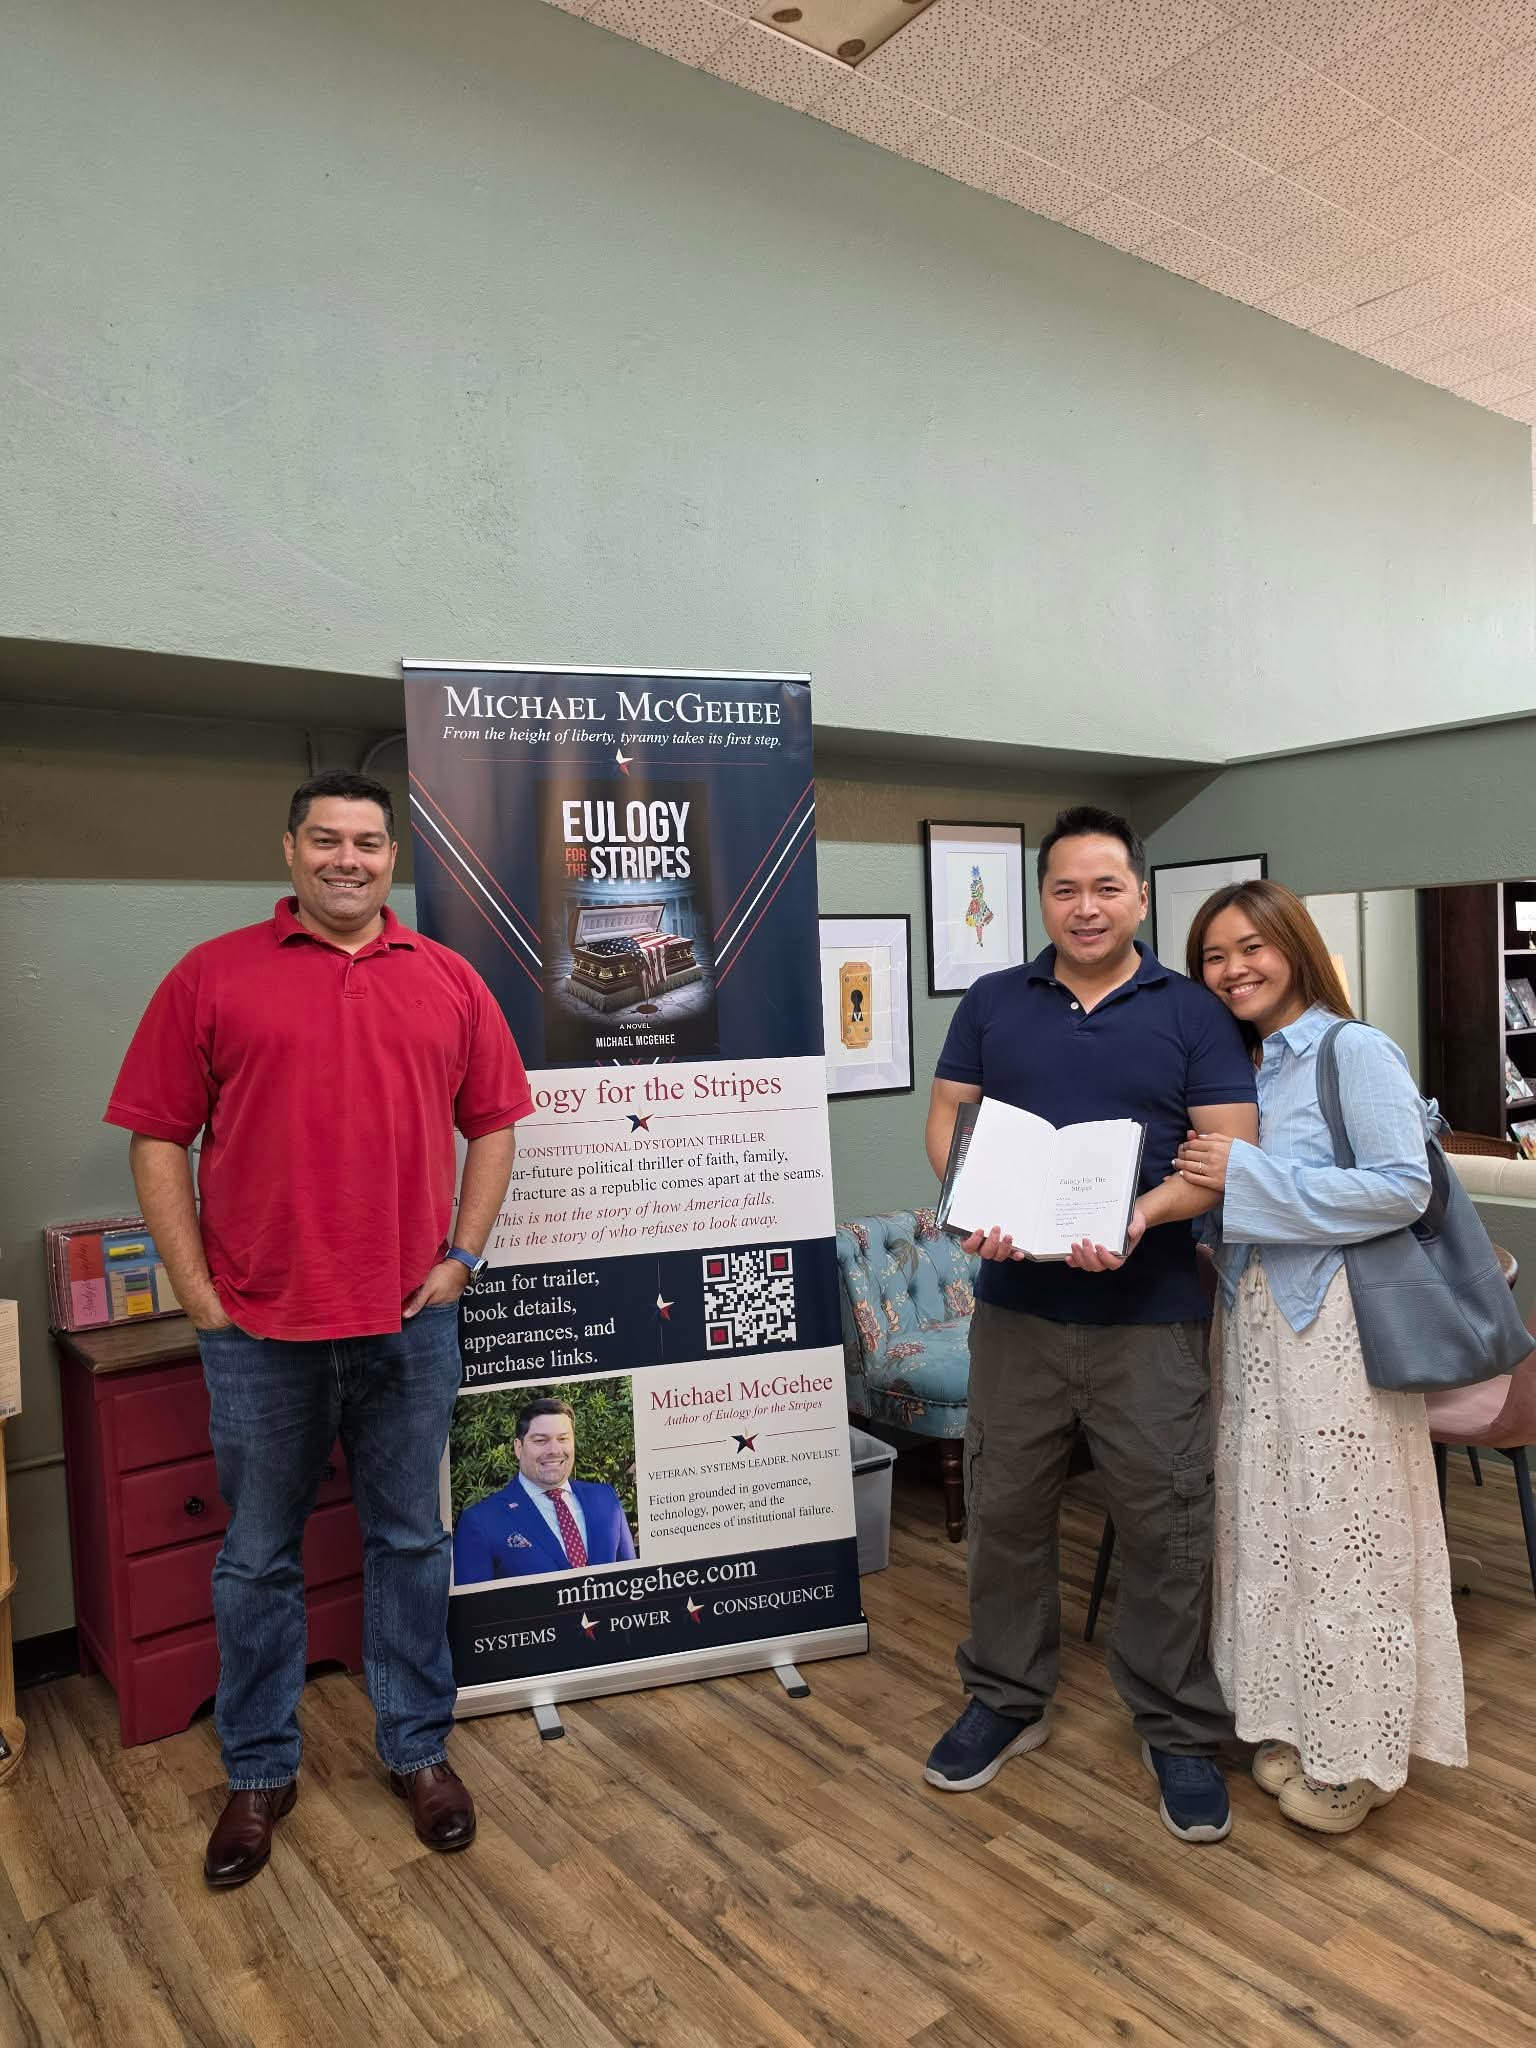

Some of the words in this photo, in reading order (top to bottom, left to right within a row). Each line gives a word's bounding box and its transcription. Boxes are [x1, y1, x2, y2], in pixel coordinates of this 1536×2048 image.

[443, 727, 479, 739] From
[485, 728, 505, 739] the
[510, 728, 550, 743] height
[555, 729, 570, 744] of
[572, 729, 615, 745] liberty,
[621, 733, 669, 746] tyranny
[673, 732, 704, 743] takes
[709, 733, 722, 744] its
[724, 733, 751, 747] first
[754, 736, 780, 748] step.
[563, 801, 690, 842] EULOGY
[566, 848, 586, 861] FOR
[591, 846, 690, 880] STRIPES
[566, 864, 586, 876] THE
[596, 1036, 633, 1047] MICHAEL
[636, 1034, 675, 1045] MCGEHEE
[598, 1080, 635, 1103] for
[644, 1077, 683, 1101] the
[694, 1073, 781, 1102] Stripes
[518, 1140, 630, 1158] CONSTITUTIONAL
[634, 1137, 703, 1150] DYSTOPIAN
[708, 1133, 765, 1145] THRILLER
[578, 1159, 632, 1179] political
[639, 1156, 684, 1170] thriller
[688, 1154, 702, 1167] of
[707, 1152, 738, 1165] faith,
[512, 1188, 566, 1201] fracture
[571, 1188, 584, 1196] as
[590, 1187, 596, 1195] a
[602, 1178, 656, 1196] republic
[662, 1178, 703, 1189] comes
[708, 1174, 739, 1188] apart
[744, 1172, 754, 1182] at
[760, 1170, 779, 1181] the
[784, 1170, 823, 1180] seams.
[495, 1213, 523, 1228] This
[529, 1212, 539, 1224] is
[545, 1211, 566, 1222] not
[572, 1207, 592, 1220] the
[597, 1208, 631, 1220] story
[636, 1202, 653, 1218] of
[653, 1201, 680, 1214] how
[685, 1197, 738, 1211] America
[741, 1192, 774, 1209] falls.
[494, 1236, 504, 1248] It
[510, 1235, 520, 1246] is
[526, 1232, 547, 1245] the
[552, 1232, 586, 1244] story
[592, 1226, 608, 1242] of
[609, 1224, 636, 1238] who
[642, 1221, 688, 1238] refuses
[693, 1222, 705, 1230] to
[710, 1215, 736, 1229] look
[742, 1216, 777, 1228] away.
[512, 1274, 537, 1290] for
[543, 1269, 599, 1287] trailer,
[464, 1302, 508, 1322] book
[514, 1297, 576, 1316] details,
[464, 1328, 578, 1354] appearances,
[585, 1318, 615, 1336] and
[466, 1355, 544, 1381] purchase
[552, 1348, 597, 1366] links.
[651, 1383, 732, 1411] Michael
[740, 1374, 832, 1400] McGehee
[664, 1414, 700, 1425] Author
[703, 1411, 713, 1422] of
[716, 1408, 752, 1419] Eulogy
[752, 1406, 768, 1418] for
[772, 1402, 785, 1413] the
[788, 1400, 821, 1412] Stripes
[701, 1461, 745, 1473] SYSTEMS
[650, 1495, 685, 1505] Fiction
[689, 1485, 735, 1502] grounded
[740, 1484, 748, 1494] in
[752, 1478, 811, 1494] governance,
[650, 1506, 709, 1522] technology,
[712, 1503, 745, 1516] power,
[749, 1497, 766, 1508] and
[771, 1496, 784, 1505] the
[651, 1522, 720, 1537] consequences
[724, 1516, 735, 1527] of
[738, 1510, 795, 1525] institutional
[800, 1506, 833, 1516] failure.
[556, 1560, 757, 1606] mfmcgehee.com
[475, 1628, 556, 1652] SYSTEMS
[611, 1611, 670, 1631] POWER
[714, 1585, 834, 1615] CONSEQUENCE
